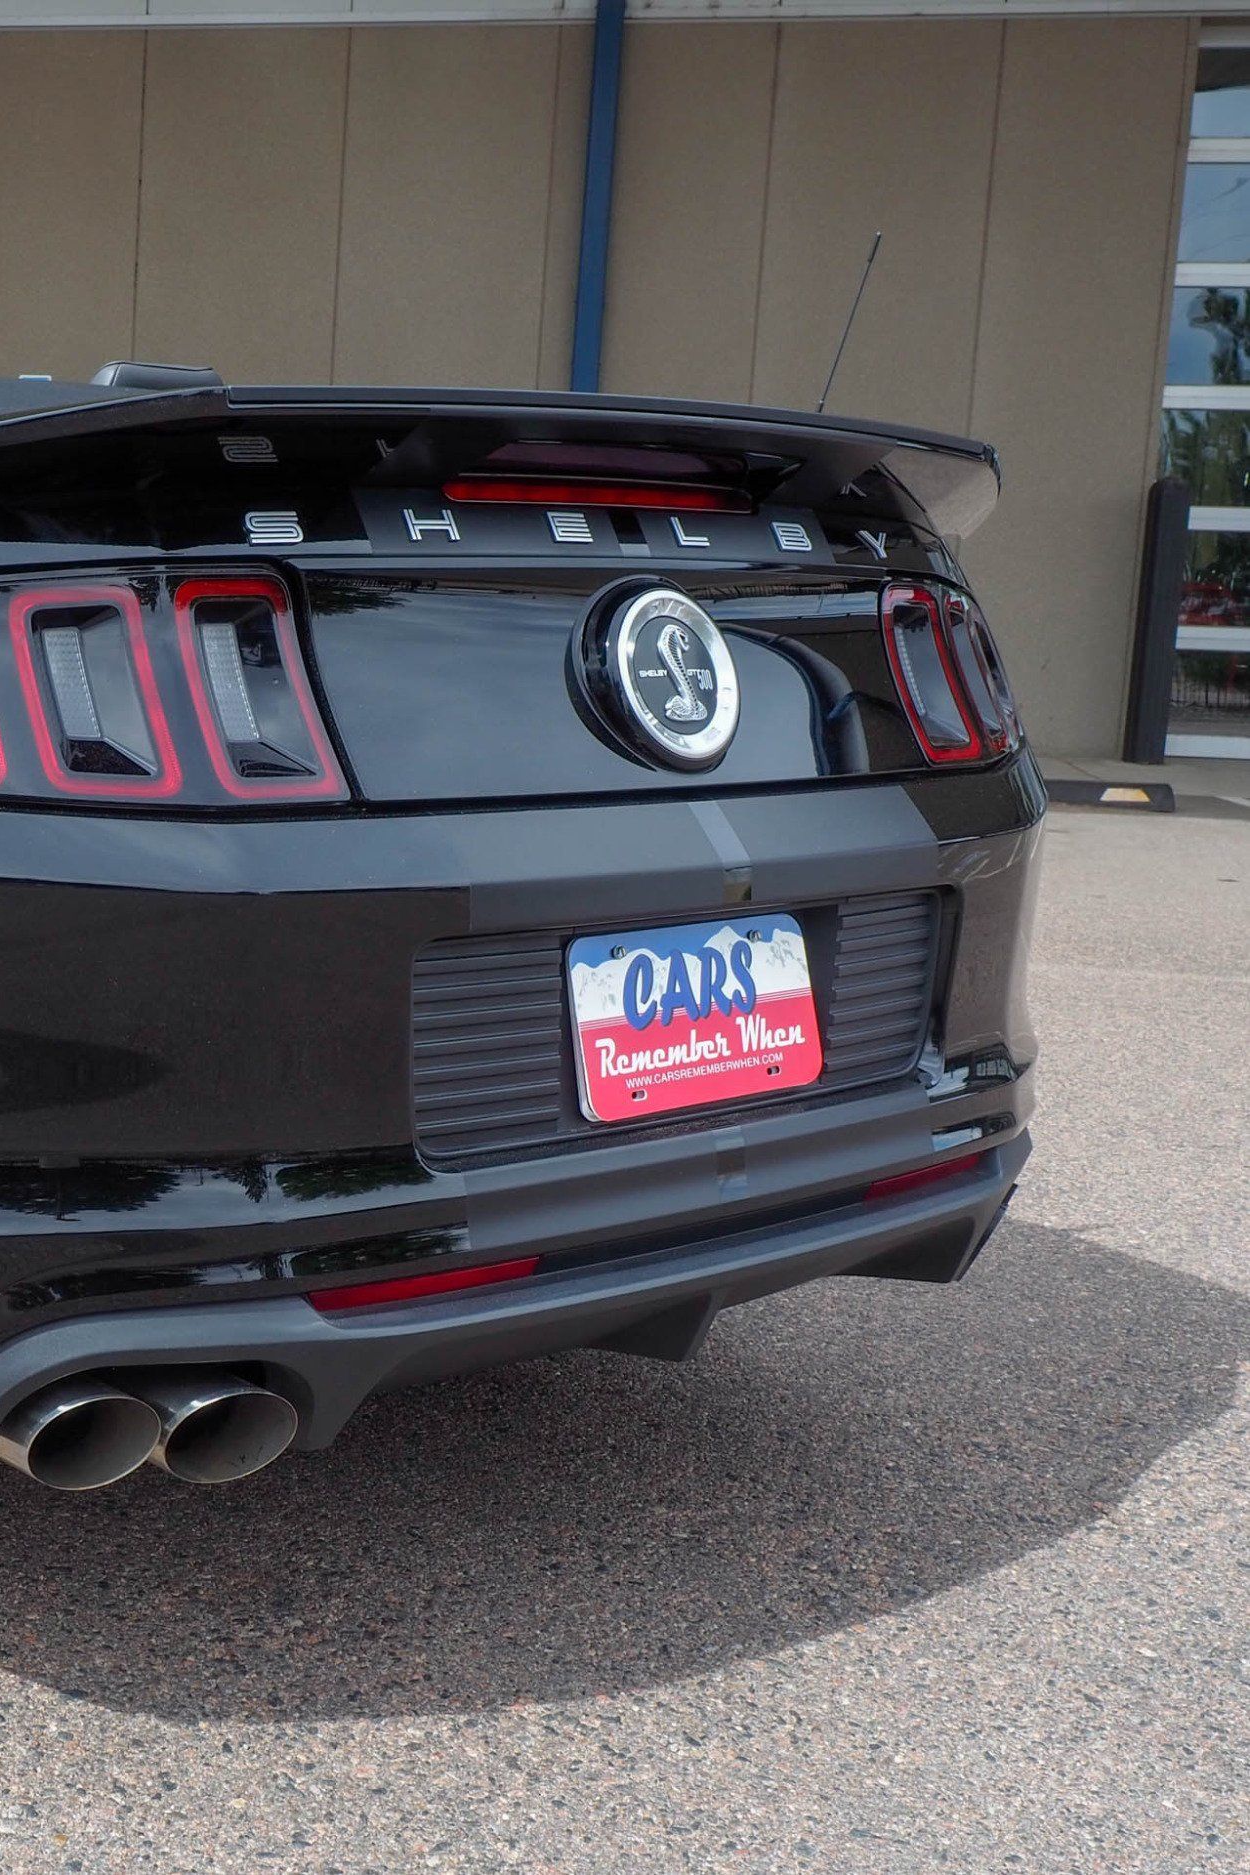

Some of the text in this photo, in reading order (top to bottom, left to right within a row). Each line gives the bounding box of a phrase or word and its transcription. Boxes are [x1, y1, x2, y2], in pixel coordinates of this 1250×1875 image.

[244, 509, 888, 560] SHELBY
[623, 940, 757, 1030] CARS
[595, 1014, 806, 1078] Remember When
[625, 1052, 784, 1089] WWW.CARSREMEMBERWHEN.COM
